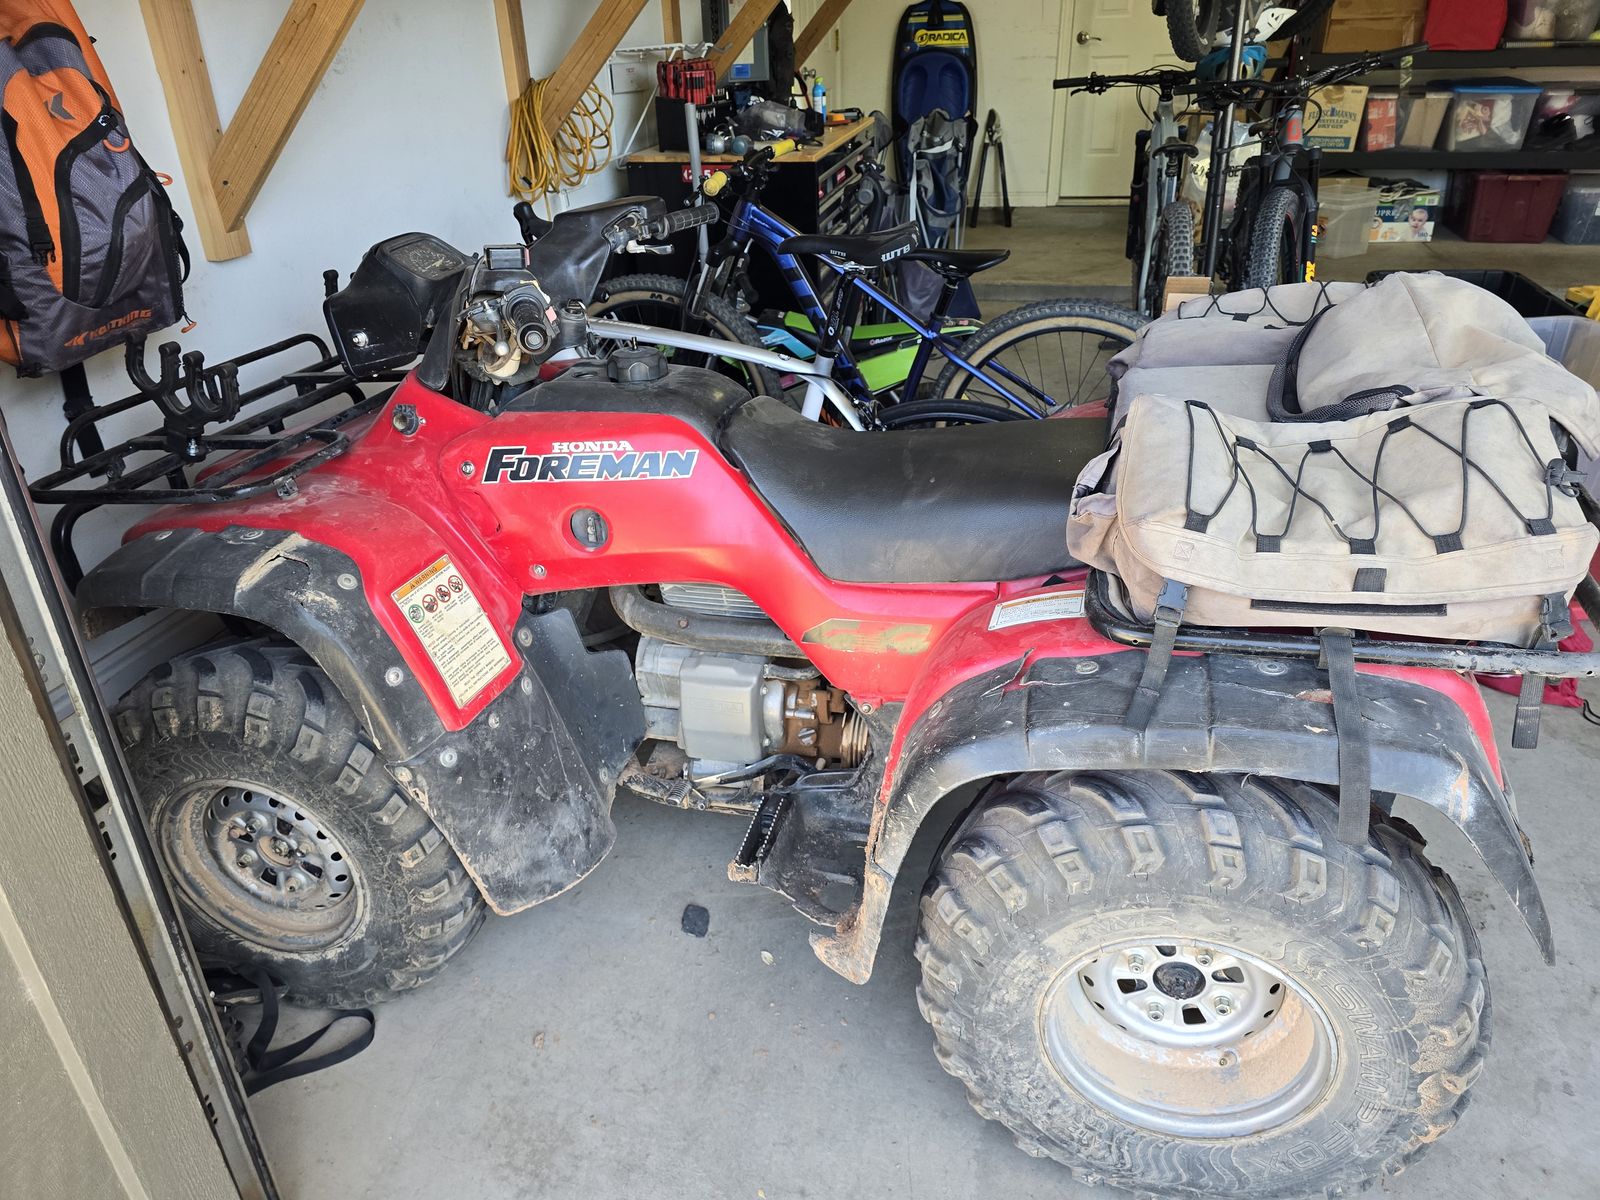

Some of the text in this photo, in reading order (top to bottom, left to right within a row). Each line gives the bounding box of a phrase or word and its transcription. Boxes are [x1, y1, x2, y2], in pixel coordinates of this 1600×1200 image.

[928, 31, 967, 42] RADICA
[880, 243, 911, 262] WTB
[551, 440, 635, 454] HONDA
[481, 448, 700, 485] FOREMAN
[413, 565, 438, 586] WARNING
[1251, 982, 1392, 1179] SWAMP FOX
